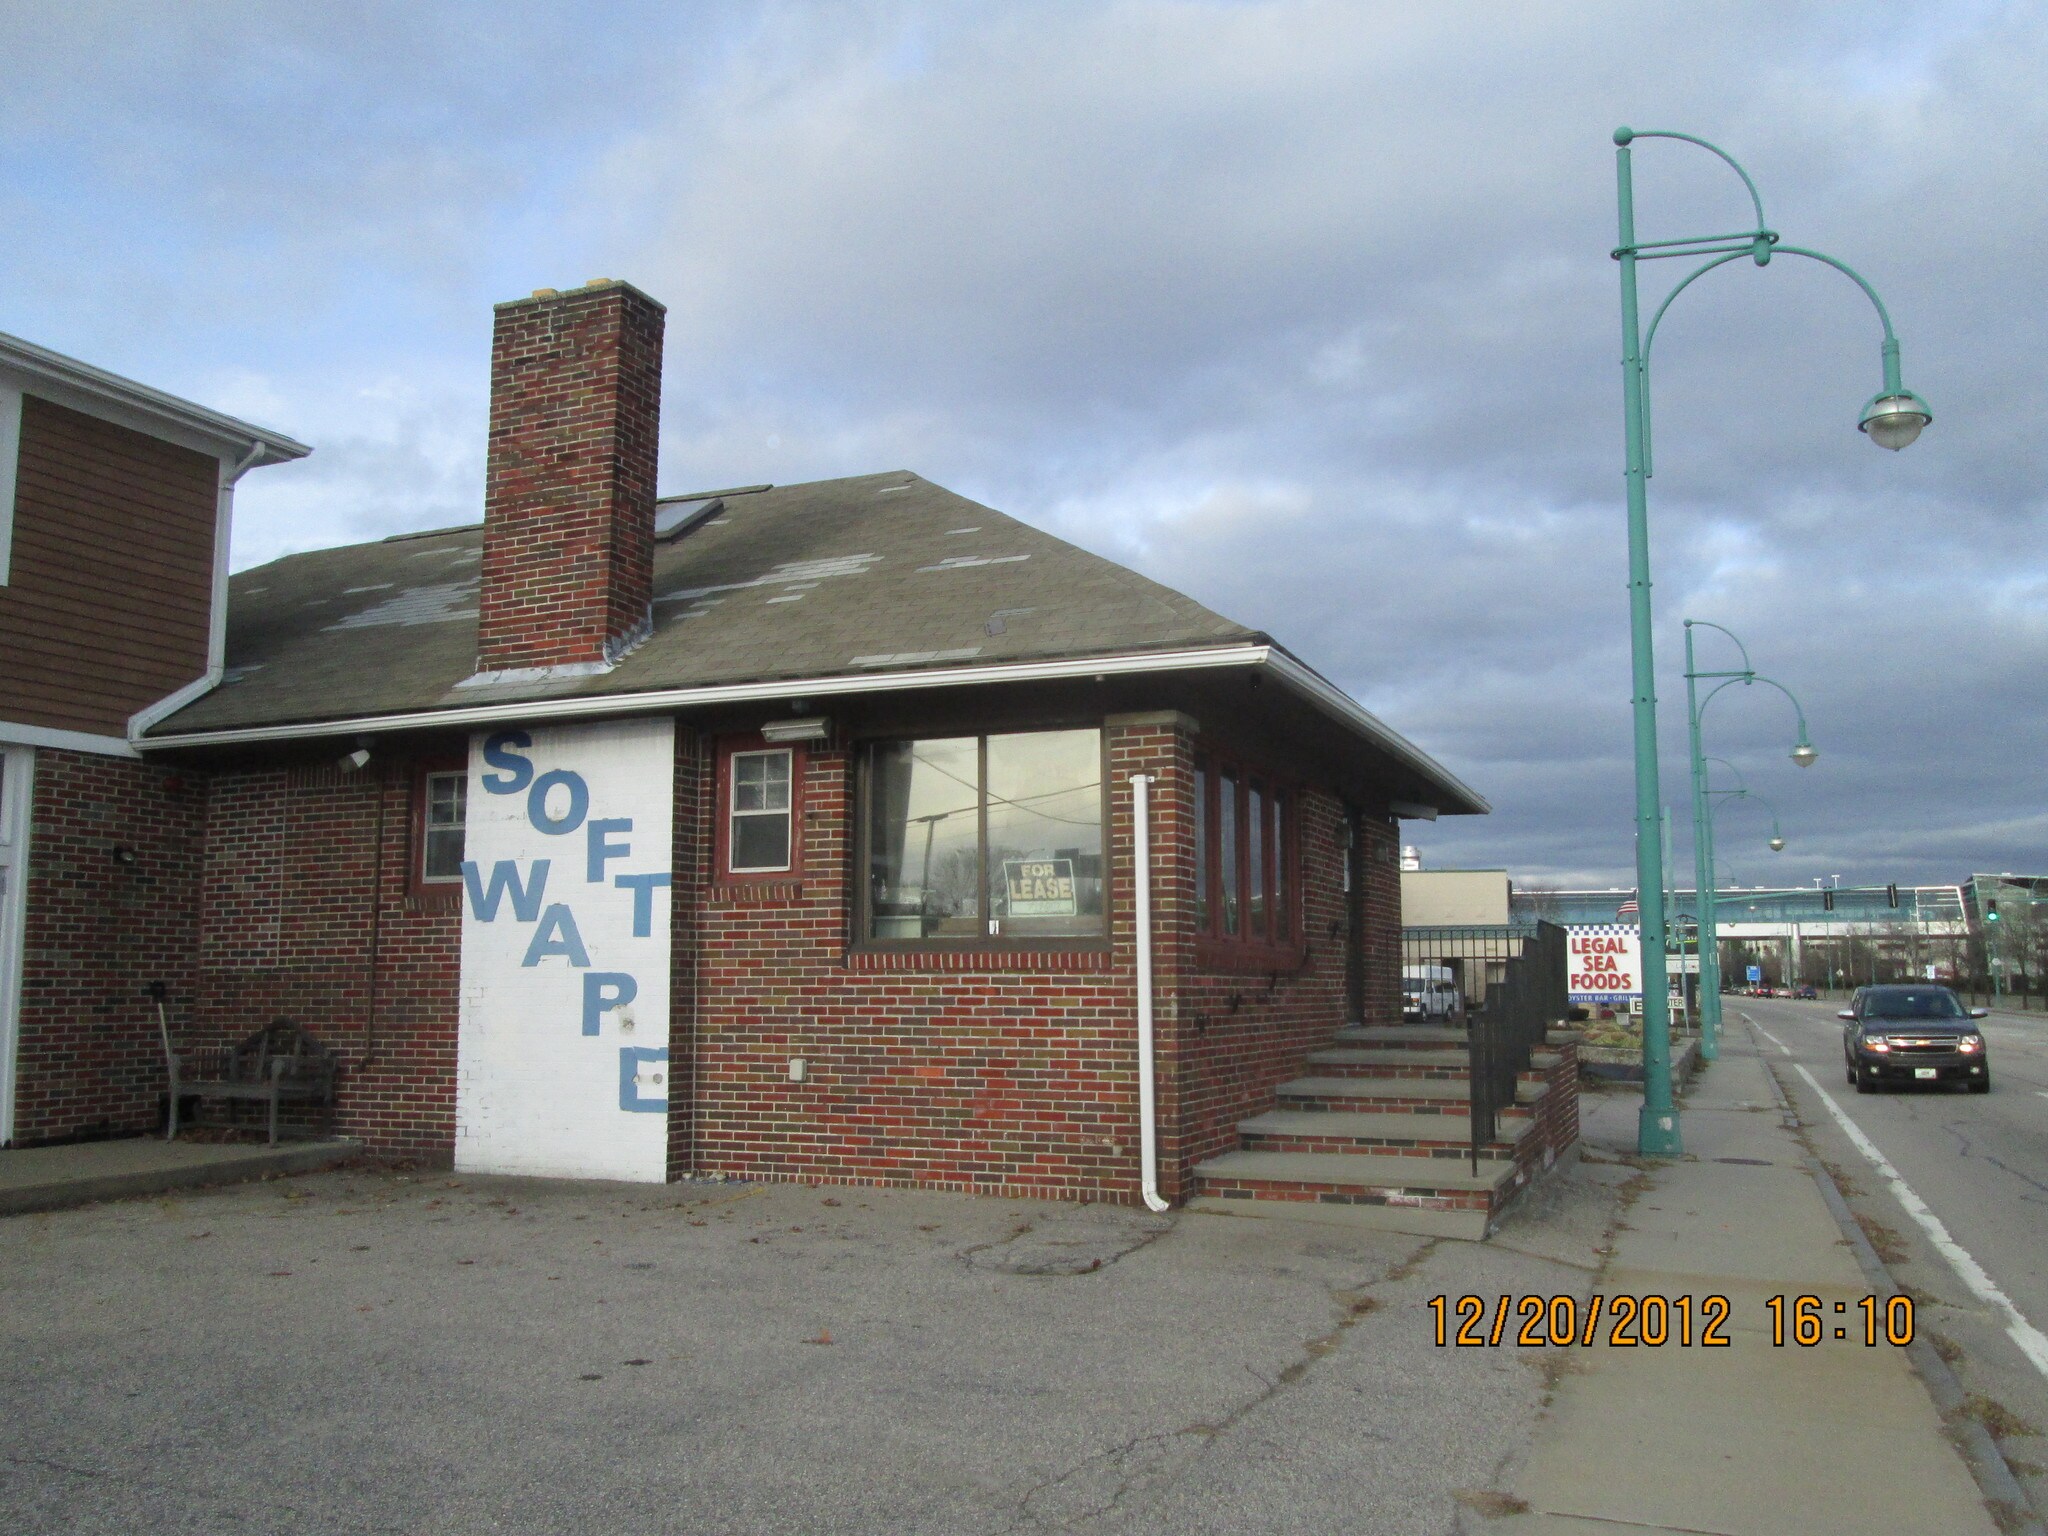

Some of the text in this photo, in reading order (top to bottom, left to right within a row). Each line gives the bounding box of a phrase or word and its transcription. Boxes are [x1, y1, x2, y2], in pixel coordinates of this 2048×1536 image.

[482, 730, 672, 938] SOFT
[1021, 864, 1055, 878] FOR
[1009, 878, 1073, 899] LEASE
[1571, 937, 1628, 954] LEGAL
[1583, 955, 1618, 972] SEA
[1570, 973, 1632, 990] FOODS
